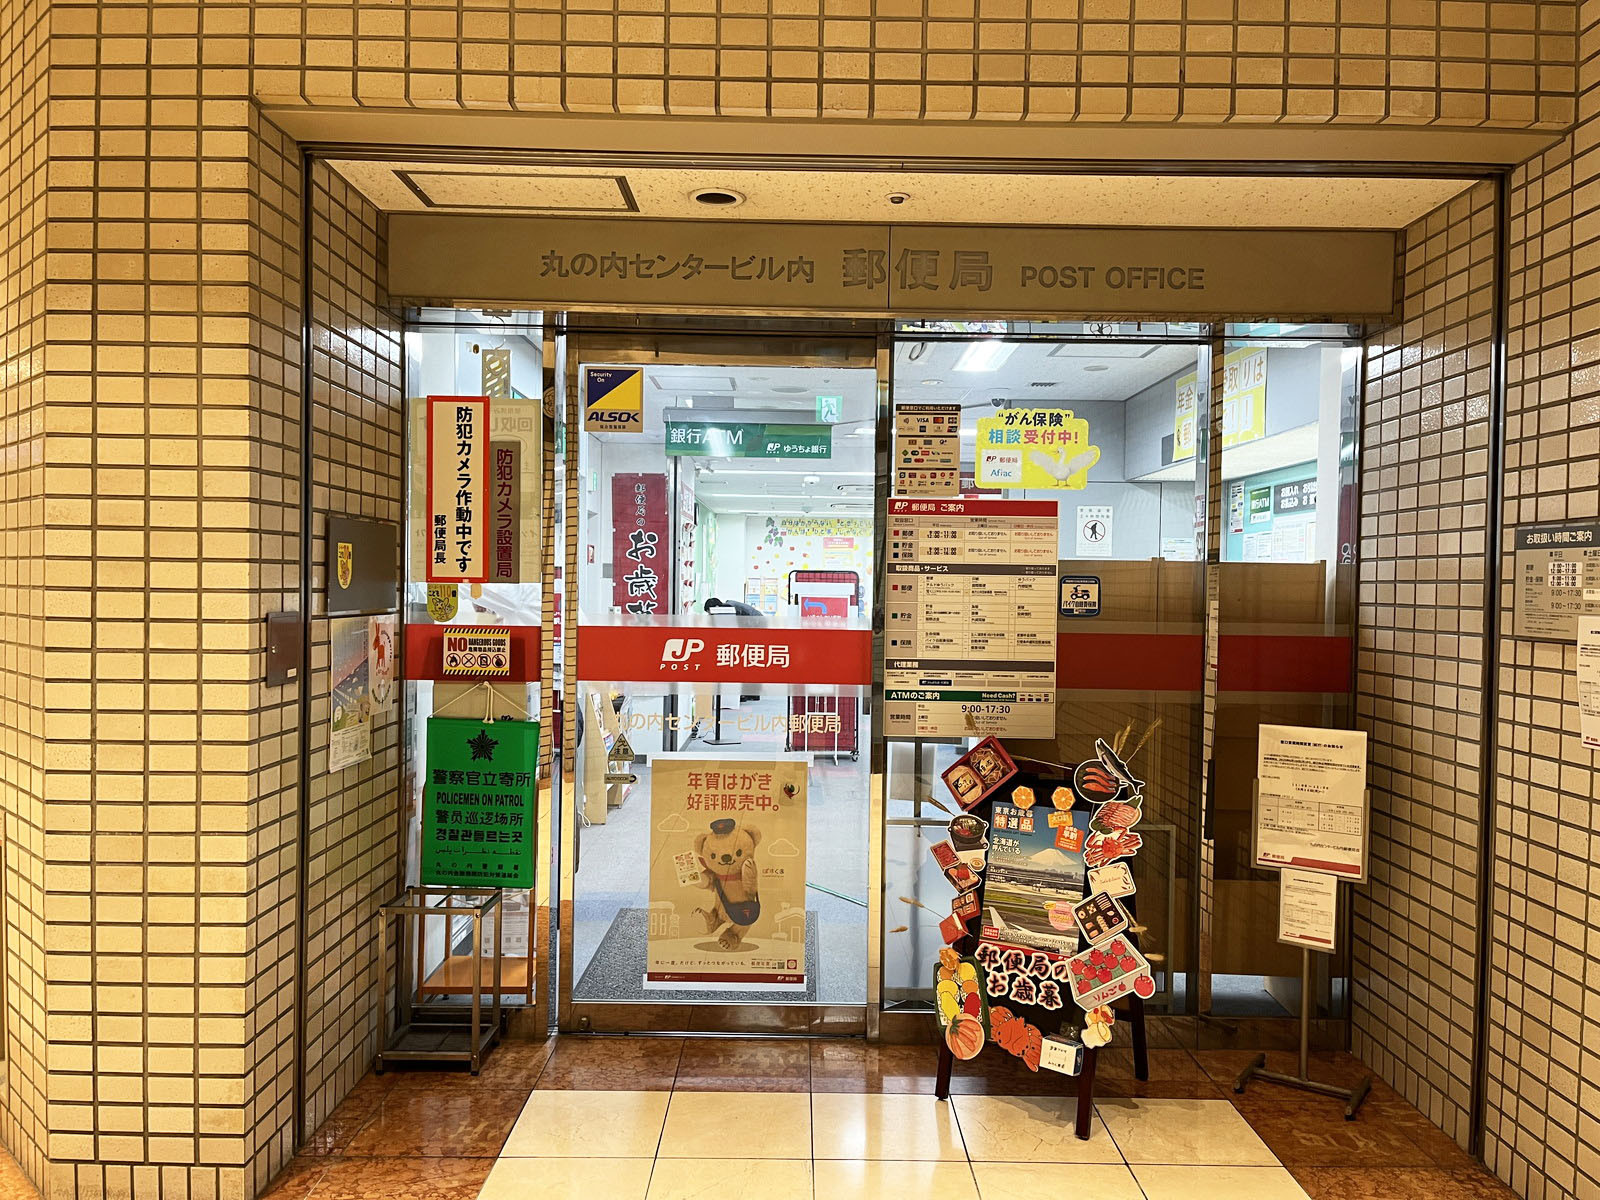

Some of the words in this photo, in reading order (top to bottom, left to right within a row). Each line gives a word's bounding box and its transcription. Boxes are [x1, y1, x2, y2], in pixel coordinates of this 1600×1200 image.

[540, 250, 815, 284] 丸の内センタービル内
[842, 248, 993, 292] 郵便局
[1021, 266, 1095, 289] POST
[1105, 266, 1205, 290] OFFICE
[588, 412, 640, 422] ALSOK
[670, 428, 744, 446] 銀行ATM
[784, 444, 827, 454] ゆうちょ銀行
[456, 406, 473, 572] 防犯カメラ作動中です
[496, 449, 512, 578] 防犯カメラ設置局
[912, 504, 936, 512] 郵便局
[940, 504, 965, 512] ご案内
[434, 514, 446, 564] 郵便局長
[1526, 530, 1592, 544] お取扱い時間ご案内
[448, 637, 468, 652] NO
[468, 638, 492, 646] DANGEROUS
[492, 638, 506, 646] GOODS
[716, 644, 790, 668] 郵便局
[890, 692, 940, 700] ATMのご案内
[961, 704, 1011, 714] 9:00-17:30
[432, 768, 530, 787] 警察官立寄所
[687, 772, 772, 791] 年賀はがき
[437, 792, 480, 806] POLICEMEN
[482, 794, 492, 806] ON
[496, 795, 524, 807] PATROL
[687, 794, 780, 811] 好評販売中。
[435, 810, 524, 827] 警员巡逻场所
[977, 944, 1069, 982] 郵便局の
[988, 972, 1062, 1010] お歳暮
[1093, 986, 1117, 1001] りんご
